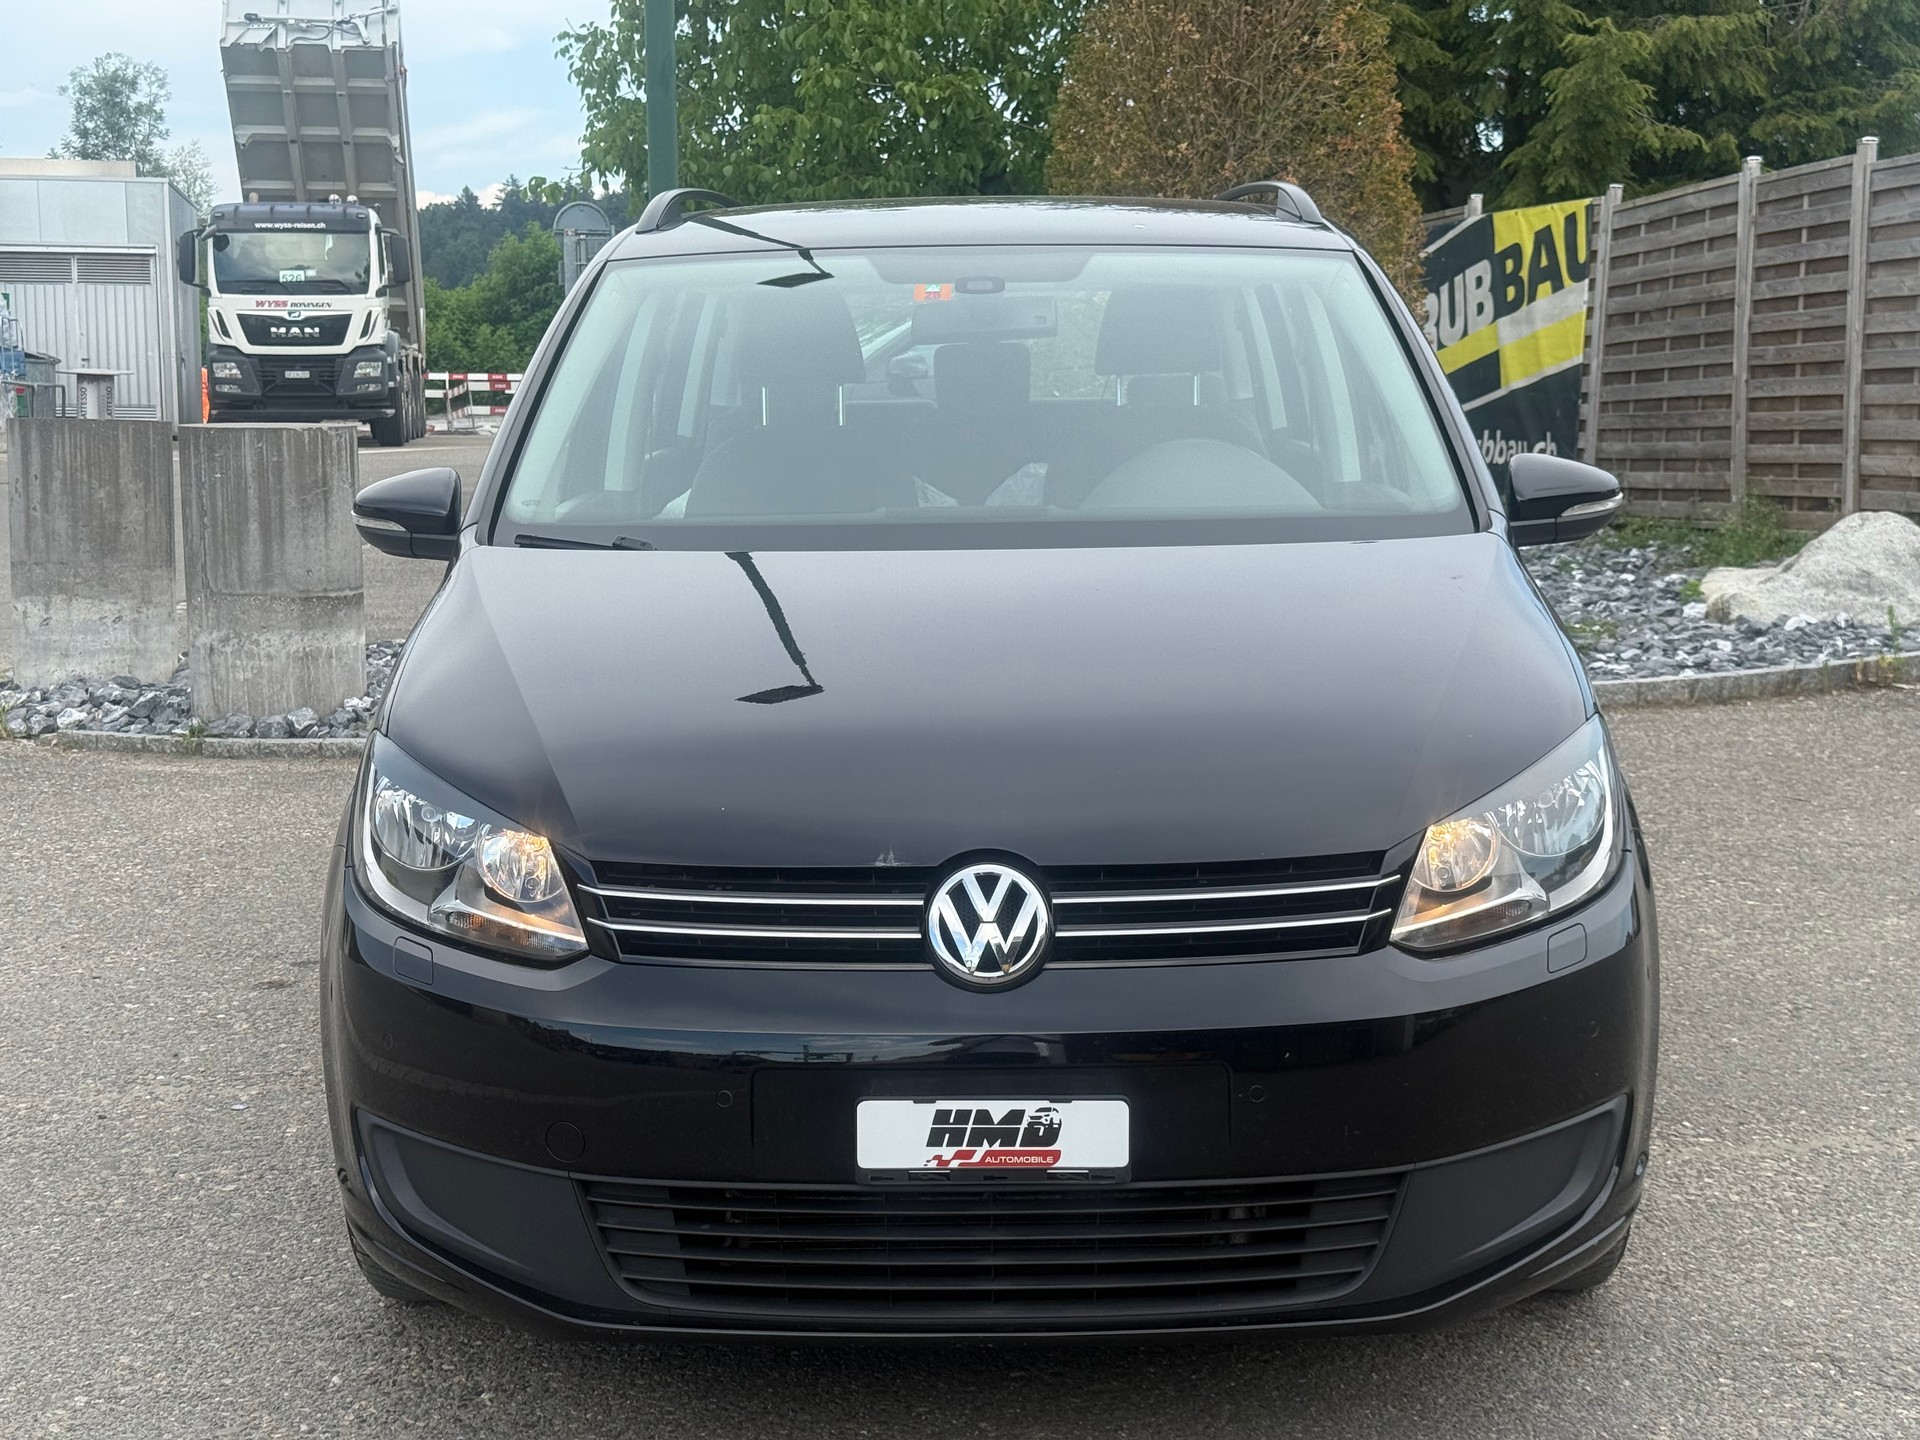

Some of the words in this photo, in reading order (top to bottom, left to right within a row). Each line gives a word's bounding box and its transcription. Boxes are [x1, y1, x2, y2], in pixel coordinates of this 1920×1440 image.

[281, 273, 302, 283] 526
[255, 300, 288, 308] WYSS
[270, 327, 320, 338] MAN
[984, 1155, 1054, 1164] AUTOMOBILE
